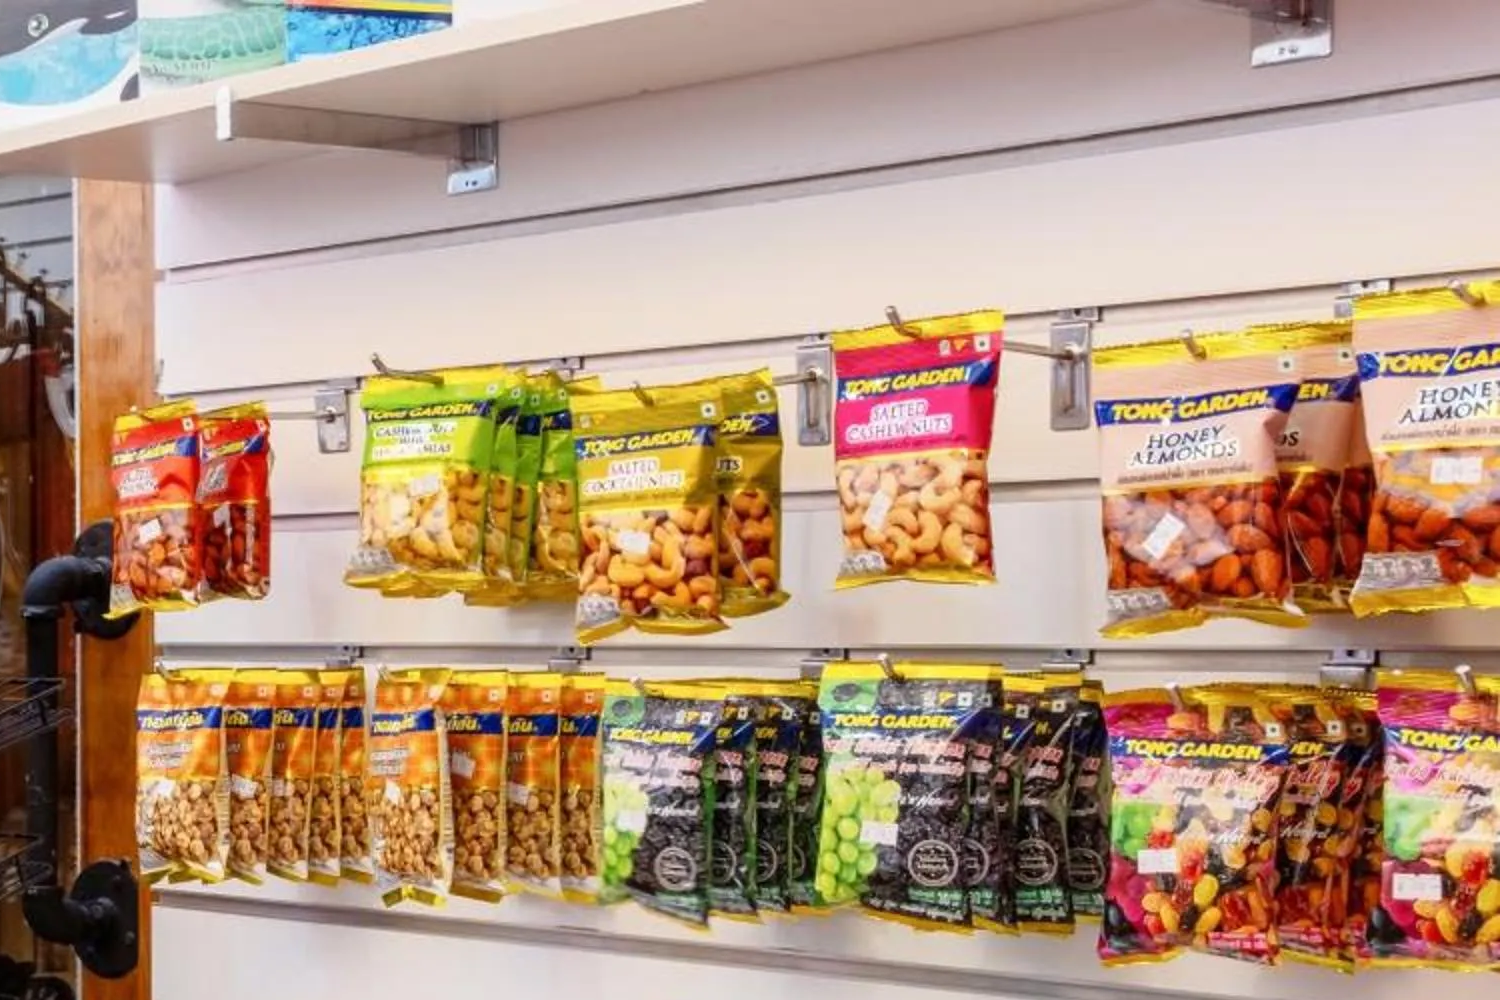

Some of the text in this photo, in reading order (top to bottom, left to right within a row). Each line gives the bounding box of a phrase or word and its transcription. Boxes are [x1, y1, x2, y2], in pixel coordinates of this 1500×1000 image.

[1379, 352, 1449, 374] TONG
[845, 367, 965, 396] TONG GARDEN
[409, 403, 476, 418] GARDEN
[873, 401, 926, 421] SALTED
[1111, 389, 1269, 421] TONG GARDEN
[1398, 400, 1493, 424] ALMON
[583, 427, 695, 452] TONG GARDEN
[849, 416, 950, 441] CASHEW NUTS
[1147, 424, 1225, 450] HONEY
[1129, 441, 1238, 466] ALMONDS
[610, 458, 659, 476] SALTED
[834, 713, 956, 730] TONG GARDEN
[1126, 739, 1263, 761] TONG GARDEN
[1400, 729, 1461, 751] TONG
